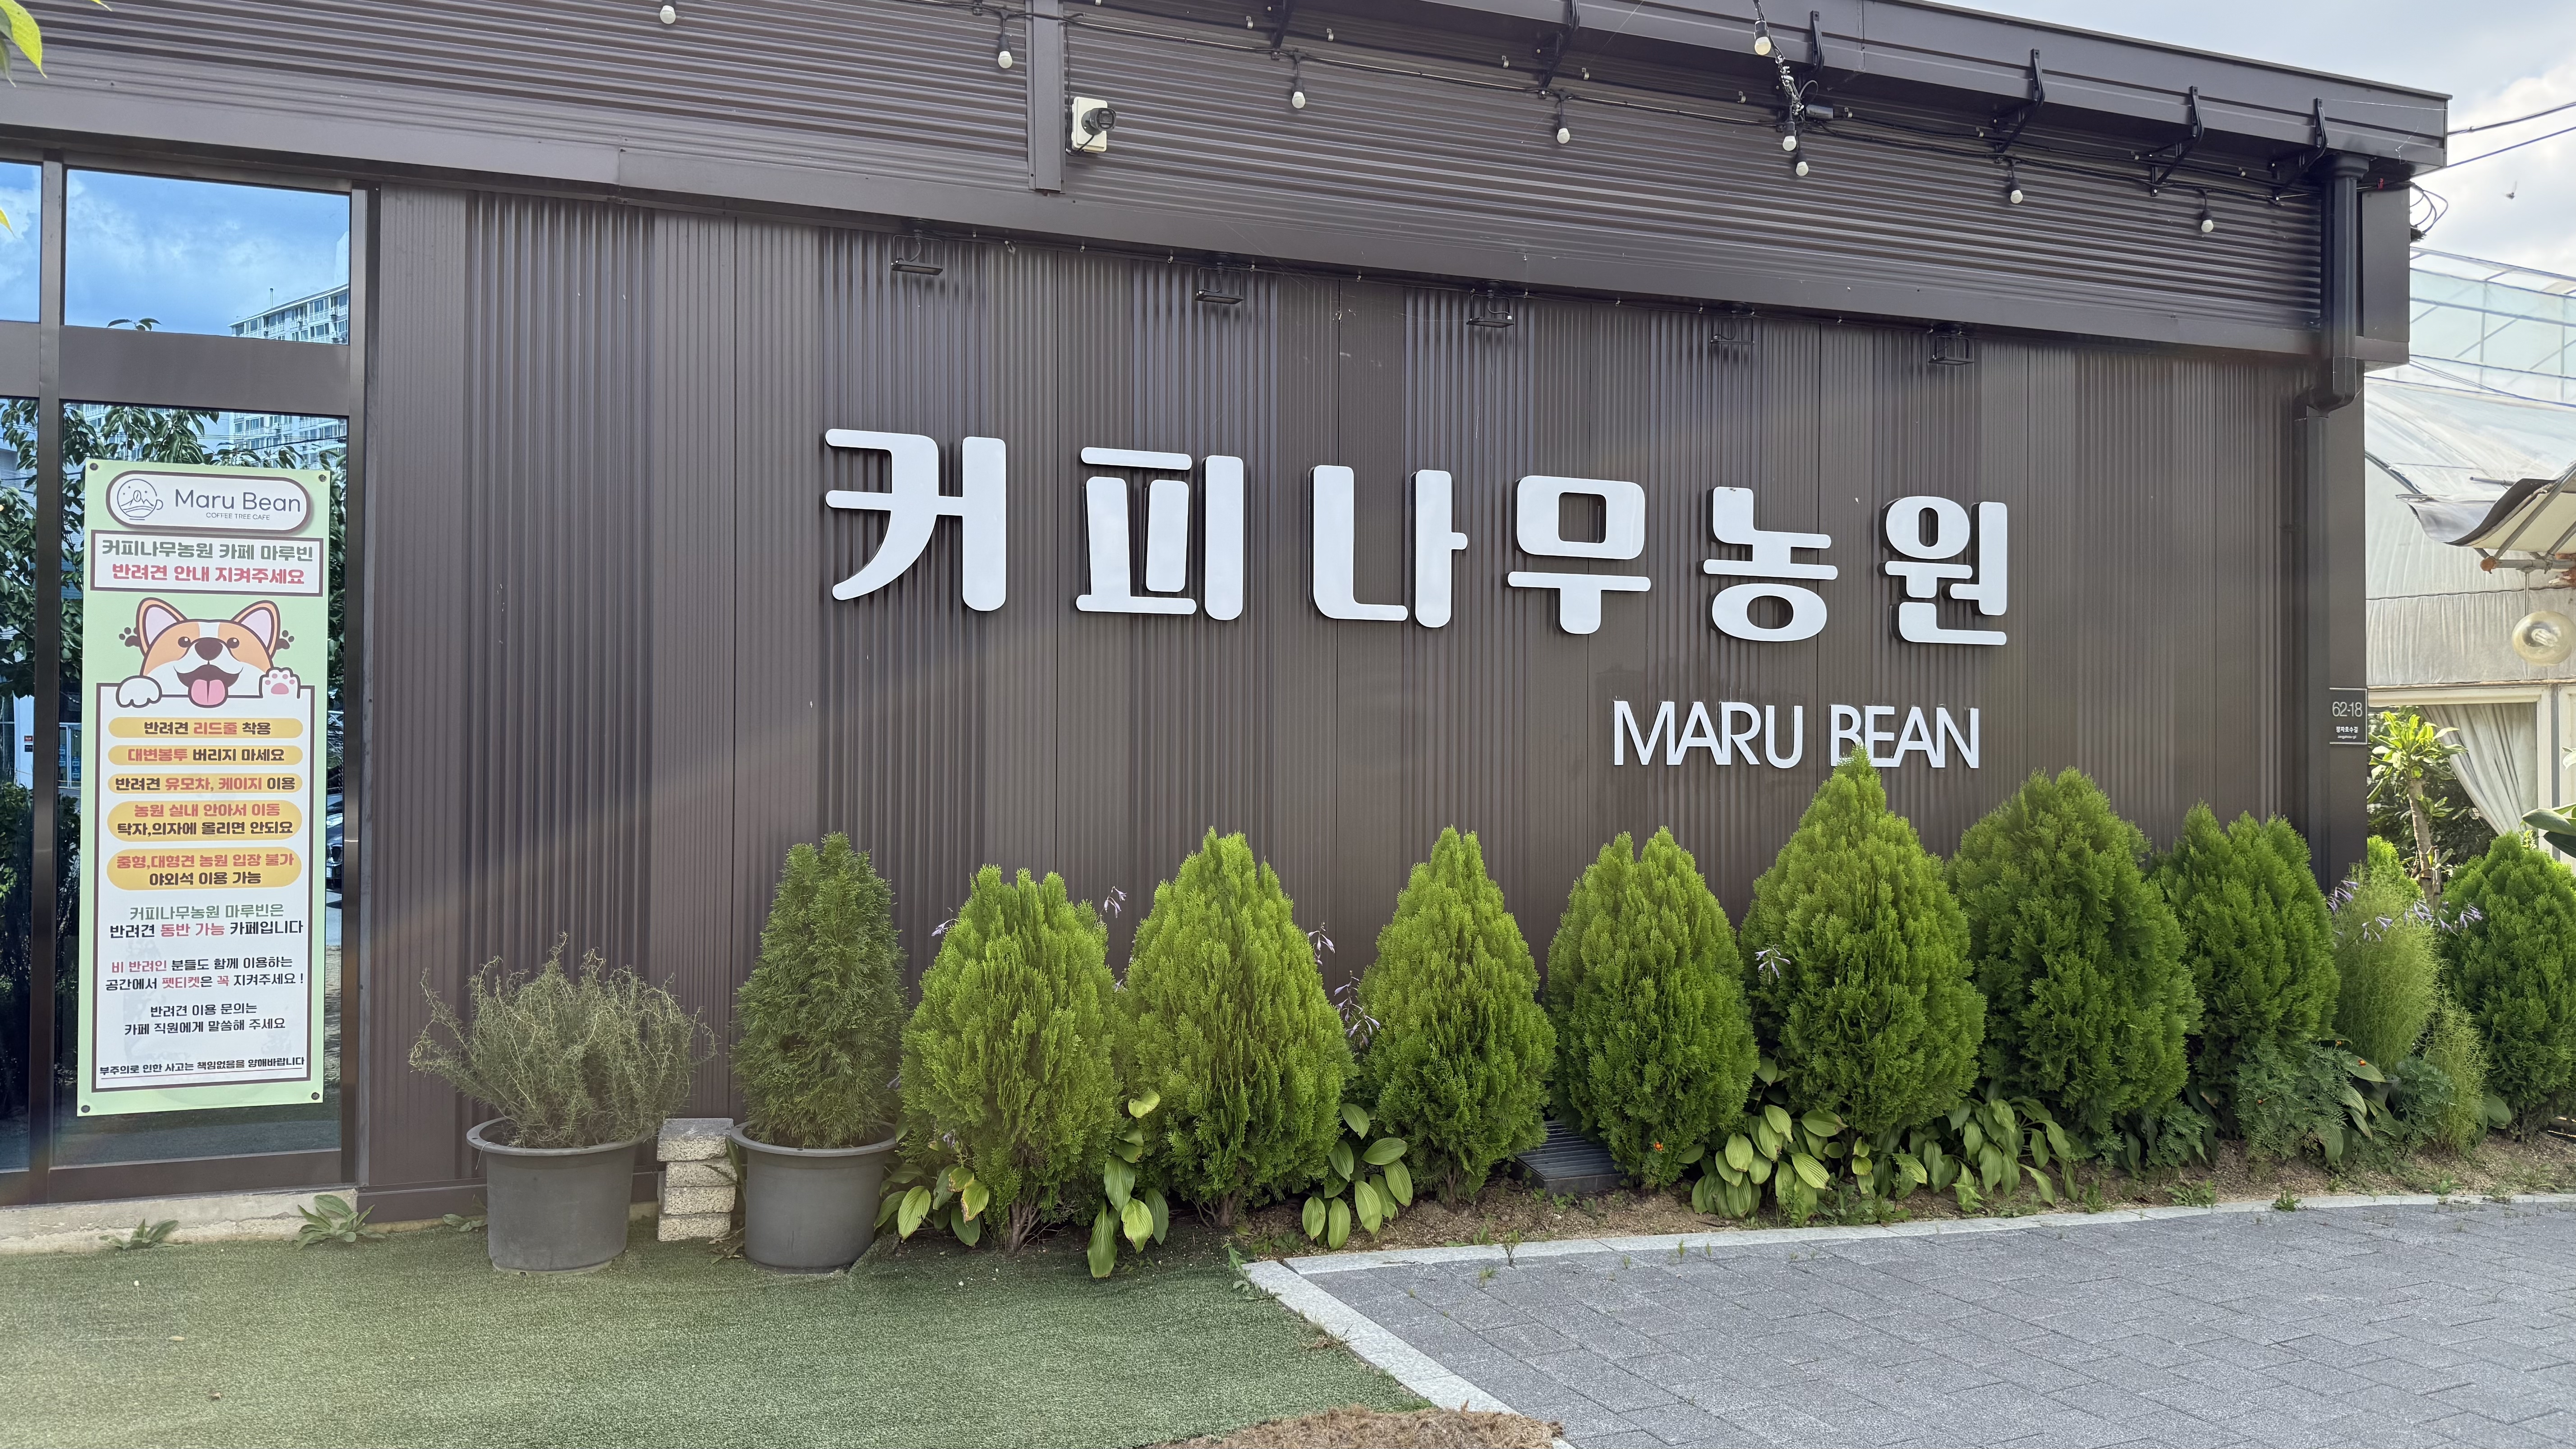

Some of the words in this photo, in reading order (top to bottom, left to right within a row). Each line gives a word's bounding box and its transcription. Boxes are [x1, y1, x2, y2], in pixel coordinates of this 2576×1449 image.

[175, 489, 234, 509] Maru
[243, 492, 300, 512] Bean
[825, 428, 2007, 645] 커피나무농원
[102, 540, 213, 559] 커피나무농원
[219, 543, 254, 560] 카페
[261, 545, 313, 562] 마루빈
[112, 564, 168, 581] 반려견
[174, 566, 209, 582] 안내
[215, 567, 304, 584] 지켜주세요
[2332, 701, 2363, 717] 62-18
[144, 722, 189, 735] 반려견
[193, 722, 237, 735] 리드줄
[242, 722, 271, 735] 착용
[1613, 700, 1803, 768] MARU
[1829, 704, 1979, 768] BEAN
[128, 748, 188, 762] 대변봉투
[193, 749, 236, 761] 버리지
[241, 749, 285, 761] 마세요
[115, 777, 160, 791] 반려견
[165, 777, 214, 792] 유모차,
[218, 777, 262, 790] 케이지
[267, 777, 295, 790] 이용
[134, 804, 164, 818] 농원
[169, 804, 198, 817] 실내
[203, 803, 247, 817] 안아서
[252, 803, 280, 816] 이동
[117, 822, 197, 837] 탁자,의자에
[201, 822, 245, 835] 올리면
[250, 821, 293, 834] 안되요
[116, 855, 195, 870] 중형,대형견
[199, 854, 228, 867] 농원
[233, 854, 262, 867] 입장
[265, 853, 294, 866] 불가
[149, 872, 193, 886] 야외석
[198, 872, 228, 885] 이용
[232, 871, 261, 884] 가능
[130, 905, 219, 920] 커피나무농원
[225, 904, 284, 918] 마루빈은
[110, 924, 155, 938] 반려견
[160, 923, 191, 937] 동반
[195, 923, 225, 936] 가능
[230, 920, 304, 935] 카페입니다
[112, 961, 124, 973] 비
[129, 960, 167, 973] 반려인
[171, 959, 209, 971] 분들도
[214, 957, 238, 970] 함께
[243, 956, 293, 968] 이용하는
[106, 978, 157, 991] 공간에서
[162, 976, 213, 989] 펫티켓은
[217, 975, 230, 987] 꼭
[234, 973, 296, 986] 지켜주세요
[151, 1005, 187, 1017] 반려견
[192, 1004, 216, 1016] 이용
[220, 1003, 258, 1015] 문의는
[124, 1023, 149, 1035] 카페
[154, 1021, 203, 1034] 직원에게
[208, 1019, 244, 1032] 말씀해
[248, 1018, 285, 1030] 주세요
[100, 1065, 139, 1076] 부주의로
[143, 1063, 162, 1073] 인한
[165, 1063, 194, 1072] 사고는
[197, 1060, 245, 1070] 책임없음을
